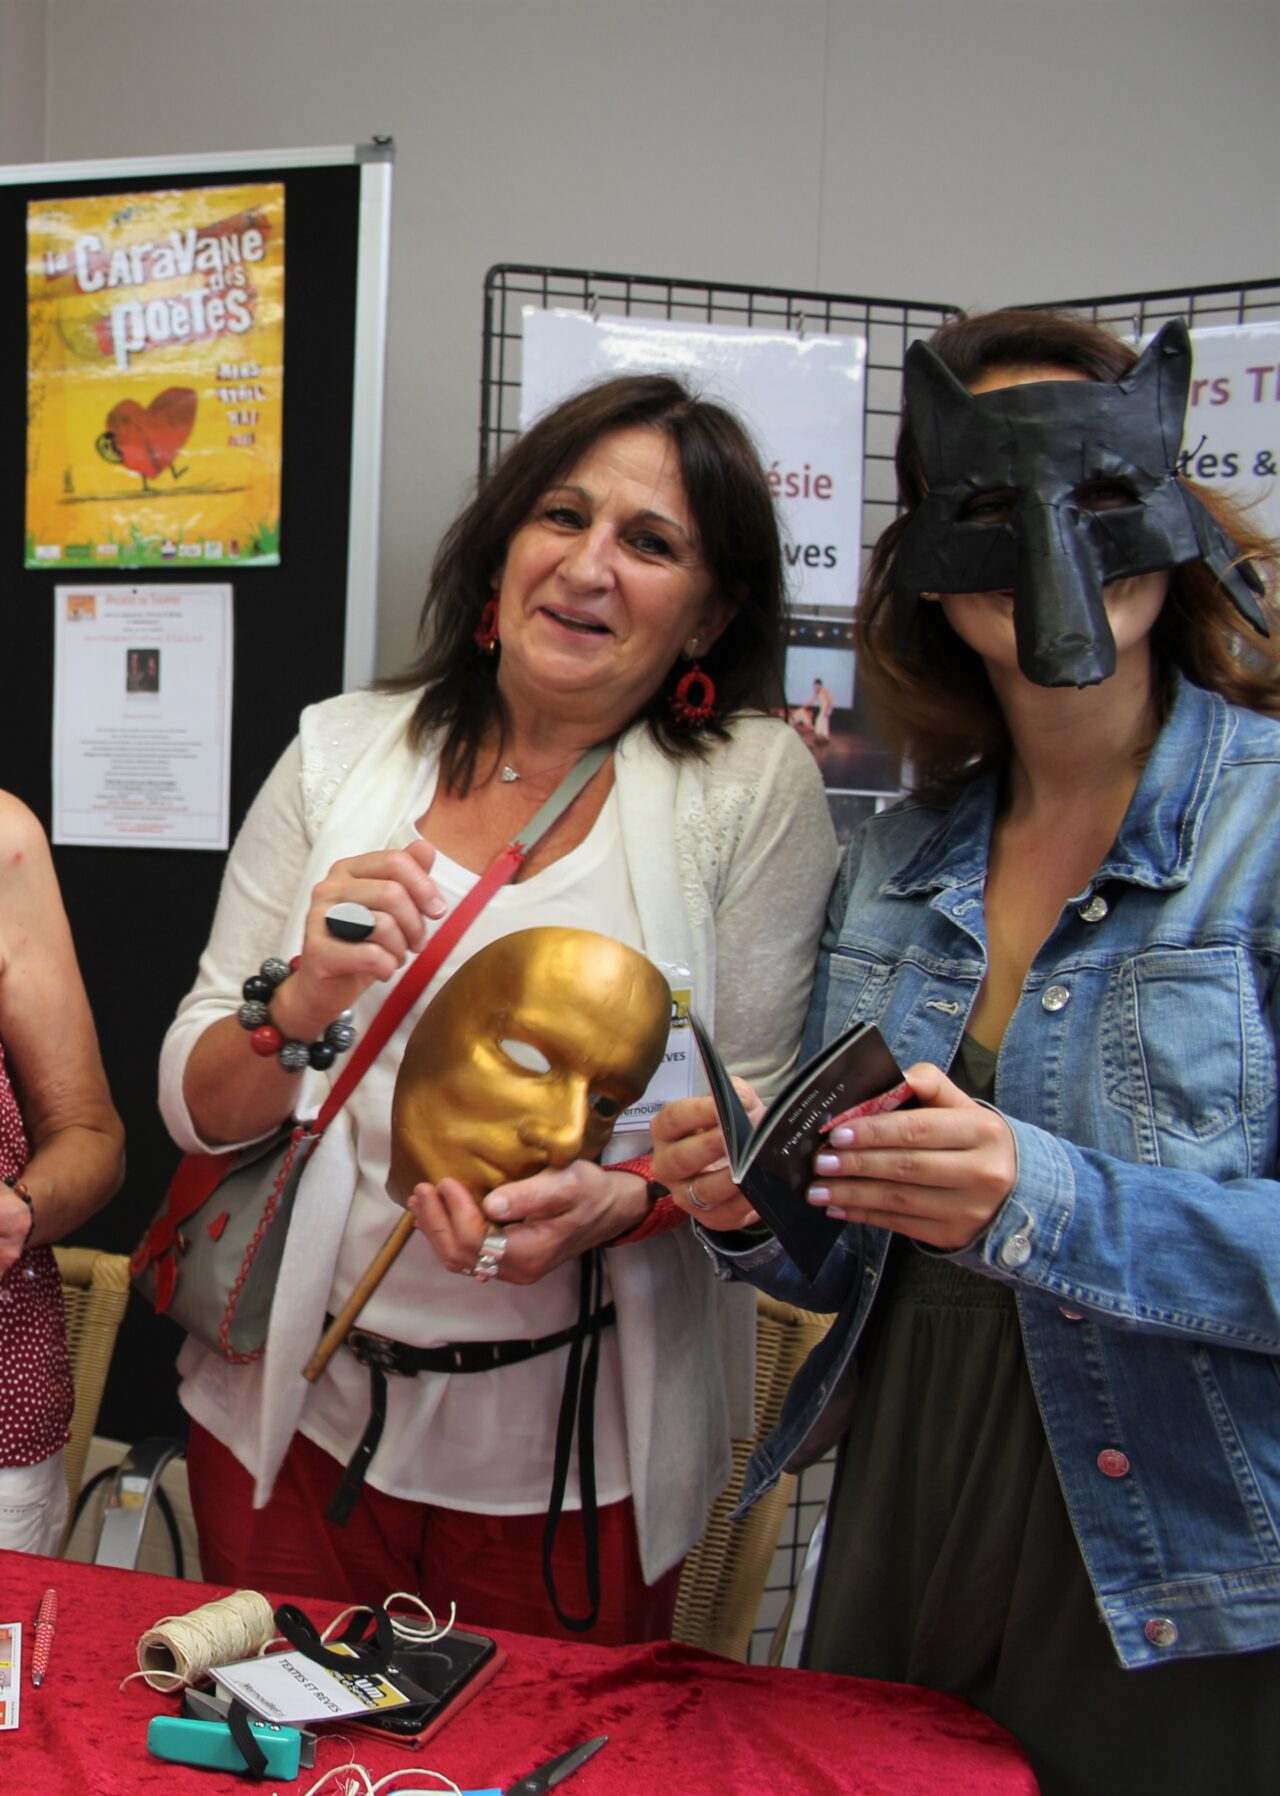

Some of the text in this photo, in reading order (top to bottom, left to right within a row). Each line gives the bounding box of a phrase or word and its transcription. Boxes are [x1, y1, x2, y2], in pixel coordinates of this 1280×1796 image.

[1191, 377, 1231, 407] rs
[1180, 450, 1278, 479] tes &
[767, 461, 833, 500] ésie
[783, 543, 838, 569] ves
[662, 1051, 687, 1064] VES
[278, 1658, 308, 1684] TEXTES
[303, 1679, 318, 1693] ET
